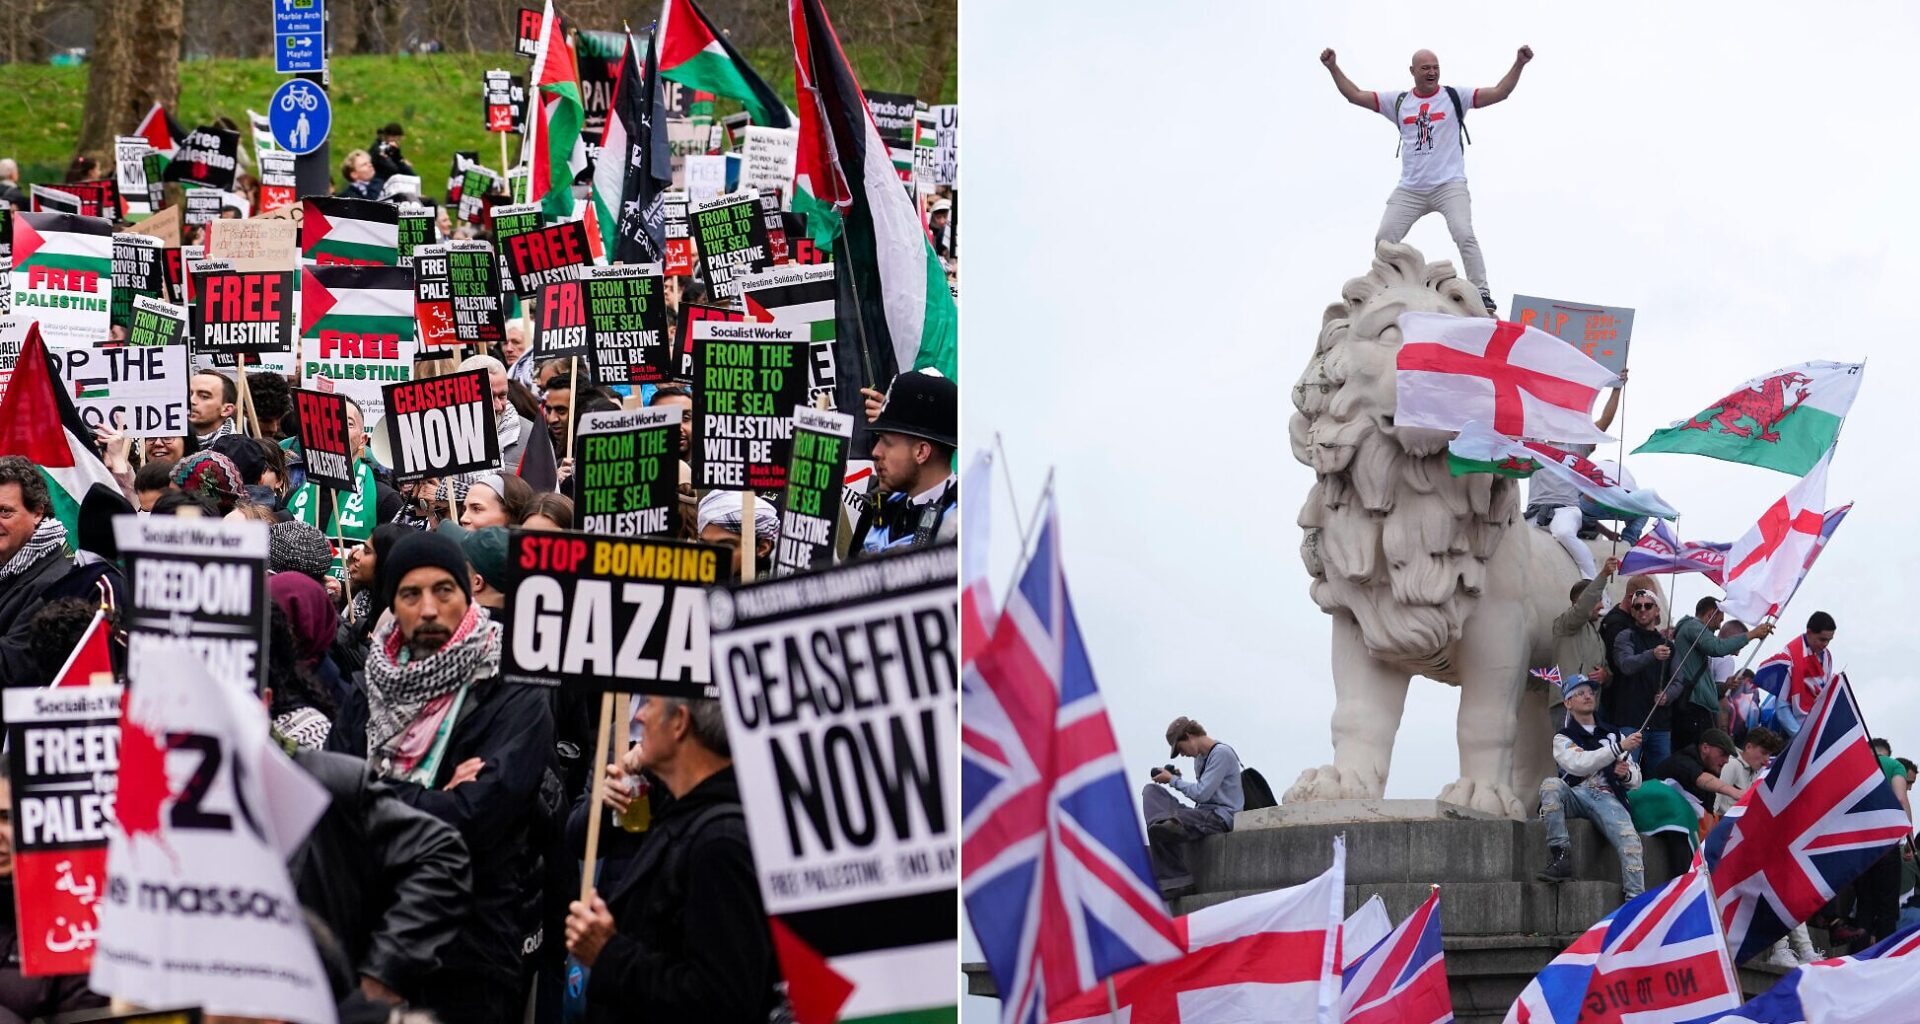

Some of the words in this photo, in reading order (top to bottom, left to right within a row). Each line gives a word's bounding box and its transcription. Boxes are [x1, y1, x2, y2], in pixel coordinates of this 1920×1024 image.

[277, 12, 302, 20] Marble
[303, 11, 321, 19] Arch
[286, 50, 313, 58] Mayfair
[289, 60, 295, 68] 5
[869, 99, 896, 115] ands
[898, 103, 915, 117] off
[176, 147, 235, 170] alestine
[699, 199, 727, 210] Socialist
[727, 194, 750, 203] Worker
[411, 219, 427, 230] THE
[496, 217, 518, 229] FROM
[520, 214, 537, 226] THE
[698, 208, 731, 227] FROM
[732, 203, 754, 219] THE
[134, 237, 154, 245] Worker
[411, 231, 424, 243] TO
[701, 223, 733, 241] RIVER
[735, 219, 752, 234] TO
[112, 246, 136, 260] FROM
[137, 248, 154, 262] THE
[511, 225, 583, 273] FREE
[704, 240, 727, 256] THE
[728, 234, 750, 251] SEA
[111, 260, 137, 274] RIVER
[138, 262, 150, 276] TO
[195, 262, 213, 270] Socialist
[450, 254, 472, 267] FROM
[473, 254, 490, 268] THE
[707, 246, 766, 270] PALESTINE
[28, 264, 99, 293] FREE
[111, 274, 131, 287] THE
[132, 276, 147, 290] SEA
[451, 268, 475, 281] RIVER
[475, 268, 488, 281] TO
[520, 262, 584, 292] PALESTIN
[592, 269, 622, 277] Socialist
[622, 267, 650, 276] Worker
[742, 279, 773, 289] Palestine
[774, 273, 803, 284] Solidarity
[804, 269, 833, 280] Campaig
[204, 275, 281, 322] FREE
[453, 283, 470, 295] THE
[470, 281, 486, 295] SEA
[590, 280, 625, 297] FROM
[628, 278, 653, 295] THE
[15, 291, 108, 312] PALESTINE
[141, 300, 161, 310] Socialist
[159, 306, 179, 317] Worker
[454, 297, 497, 310] PALESTINE
[591, 297, 626, 314] RIVER
[629, 296, 647, 312] TO
[134, 311, 158, 330] FROM
[159, 316, 178, 336] THE
[456, 311, 477, 324] WILL
[477, 311, 489, 324] BE
[593, 315, 618, 331] THE
[620, 314, 643, 330] SEA
[131, 327, 155, 346] RIVER
[156, 333, 168, 346] TO
[204, 322, 280, 345] PALESTINE
[458, 325, 479, 339] FREE
[541, 325, 587, 351] PALEST
[595, 330, 660, 348] PALESTINE
[710, 326, 753, 338] Socialist
[754, 328, 793, 339] Worker
[319, 329, 400, 359] FREE
[705, 343, 754, 367] FROM
[760, 345, 794, 367] THE
[102, 346, 166, 382] THE
[596, 348, 627, 365] WILL
[628, 348, 646, 364] BE
[306, 361, 410, 381] PALESTINE
[599, 366, 628, 382] FREE
[705, 368, 754, 391] RIVER
[760, 369, 783, 392] TO
[393, 373, 483, 414] CEASEFIRE
[705, 391, 737, 414] THE
[742, 393, 775, 415] SEA
[81, 402, 183, 432] OCIDE
[297, 392, 346, 455] FREE
[591, 416, 634, 430] Socialist
[635, 412, 667, 425] Worker
[704, 415, 794, 439] PALESTINE
[818, 415, 842, 431] Worker
[396, 400, 486, 474] NOW
[585, 434, 634, 462] FROM
[639, 429, 668, 455] THE
[704, 438, 744, 461] WILL
[750, 441, 772, 463] BE
[817, 435, 841, 464] THE
[305, 448, 349, 480] PALESTINE
[585, 461, 634, 488] RIVER
[640, 457, 658, 482] TO
[704, 463, 745, 485] FREE
[771, 465, 785, 475] the
[815, 464, 830, 490] TO
[584, 488, 618, 513] THE
[622, 483, 651, 510] SEA
[801, 490, 822, 516] SEA
[583, 506, 669, 536] PALESTINE
[140, 527, 187, 546] Socialist
[190, 530, 243, 549] Worker
[520, 536, 588, 573] STOP
[593, 541, 717, 583] BOMBING
[799, 543, 813, 570] BE
[135, 559, 252, 616] FREEDOM
[735, 582, 800, 619] PALESTINE
[801, 564, 882, 604] SOLIDARITY
[883, 546, 958, 590] CAMPAIG
[512, 575, 712, 684] GAZA
[728, 602, 958, 732] CEASEFIR
[34, 697, 104, 714] Socialist
[25, 725, 121, 776] FREE
[768, 708, 946, 857] NOW
[20, 794, 117, 844] PALES
